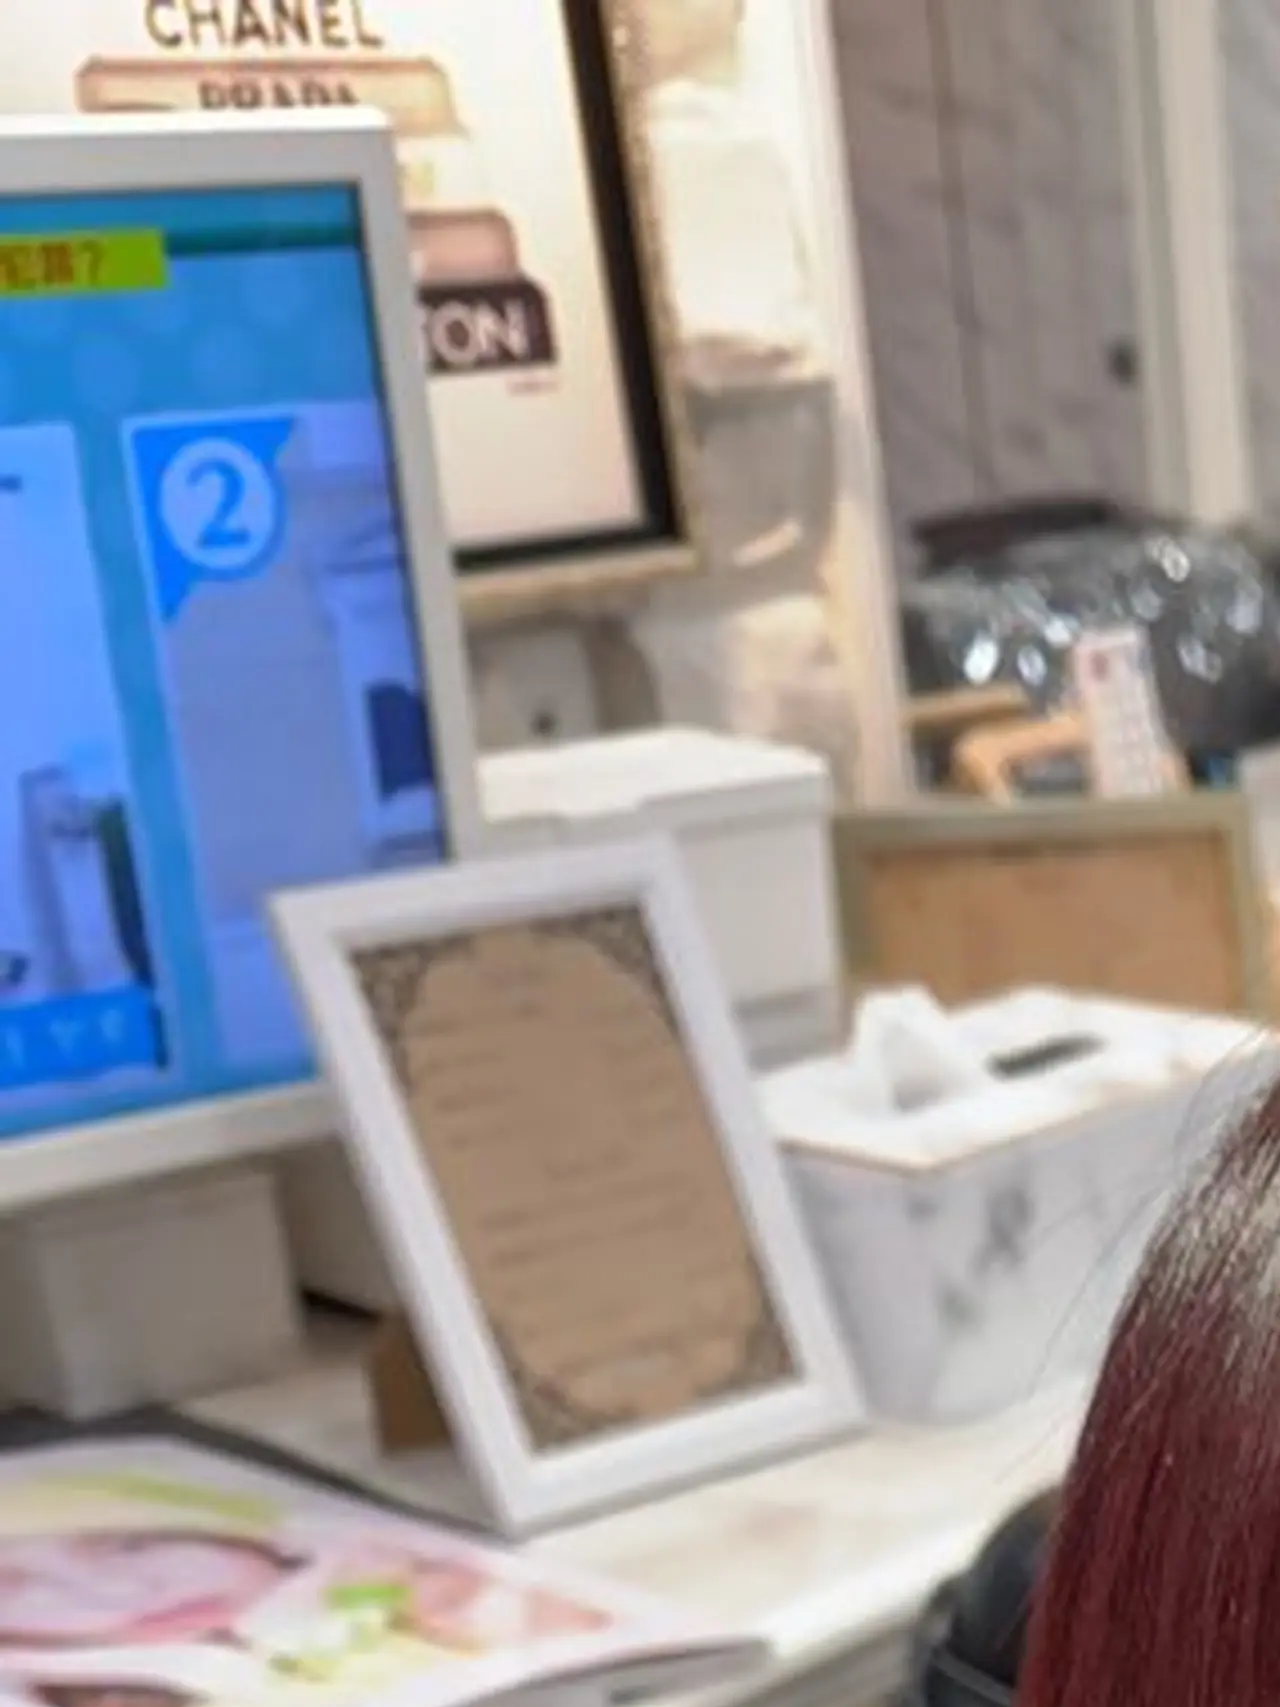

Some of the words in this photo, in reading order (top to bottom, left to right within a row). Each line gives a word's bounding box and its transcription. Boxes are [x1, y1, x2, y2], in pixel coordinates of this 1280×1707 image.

[144, 0, 386, 47] CHANEL
[420, 299, 529, 366] ON
[186, 459, 251, 549] 2
